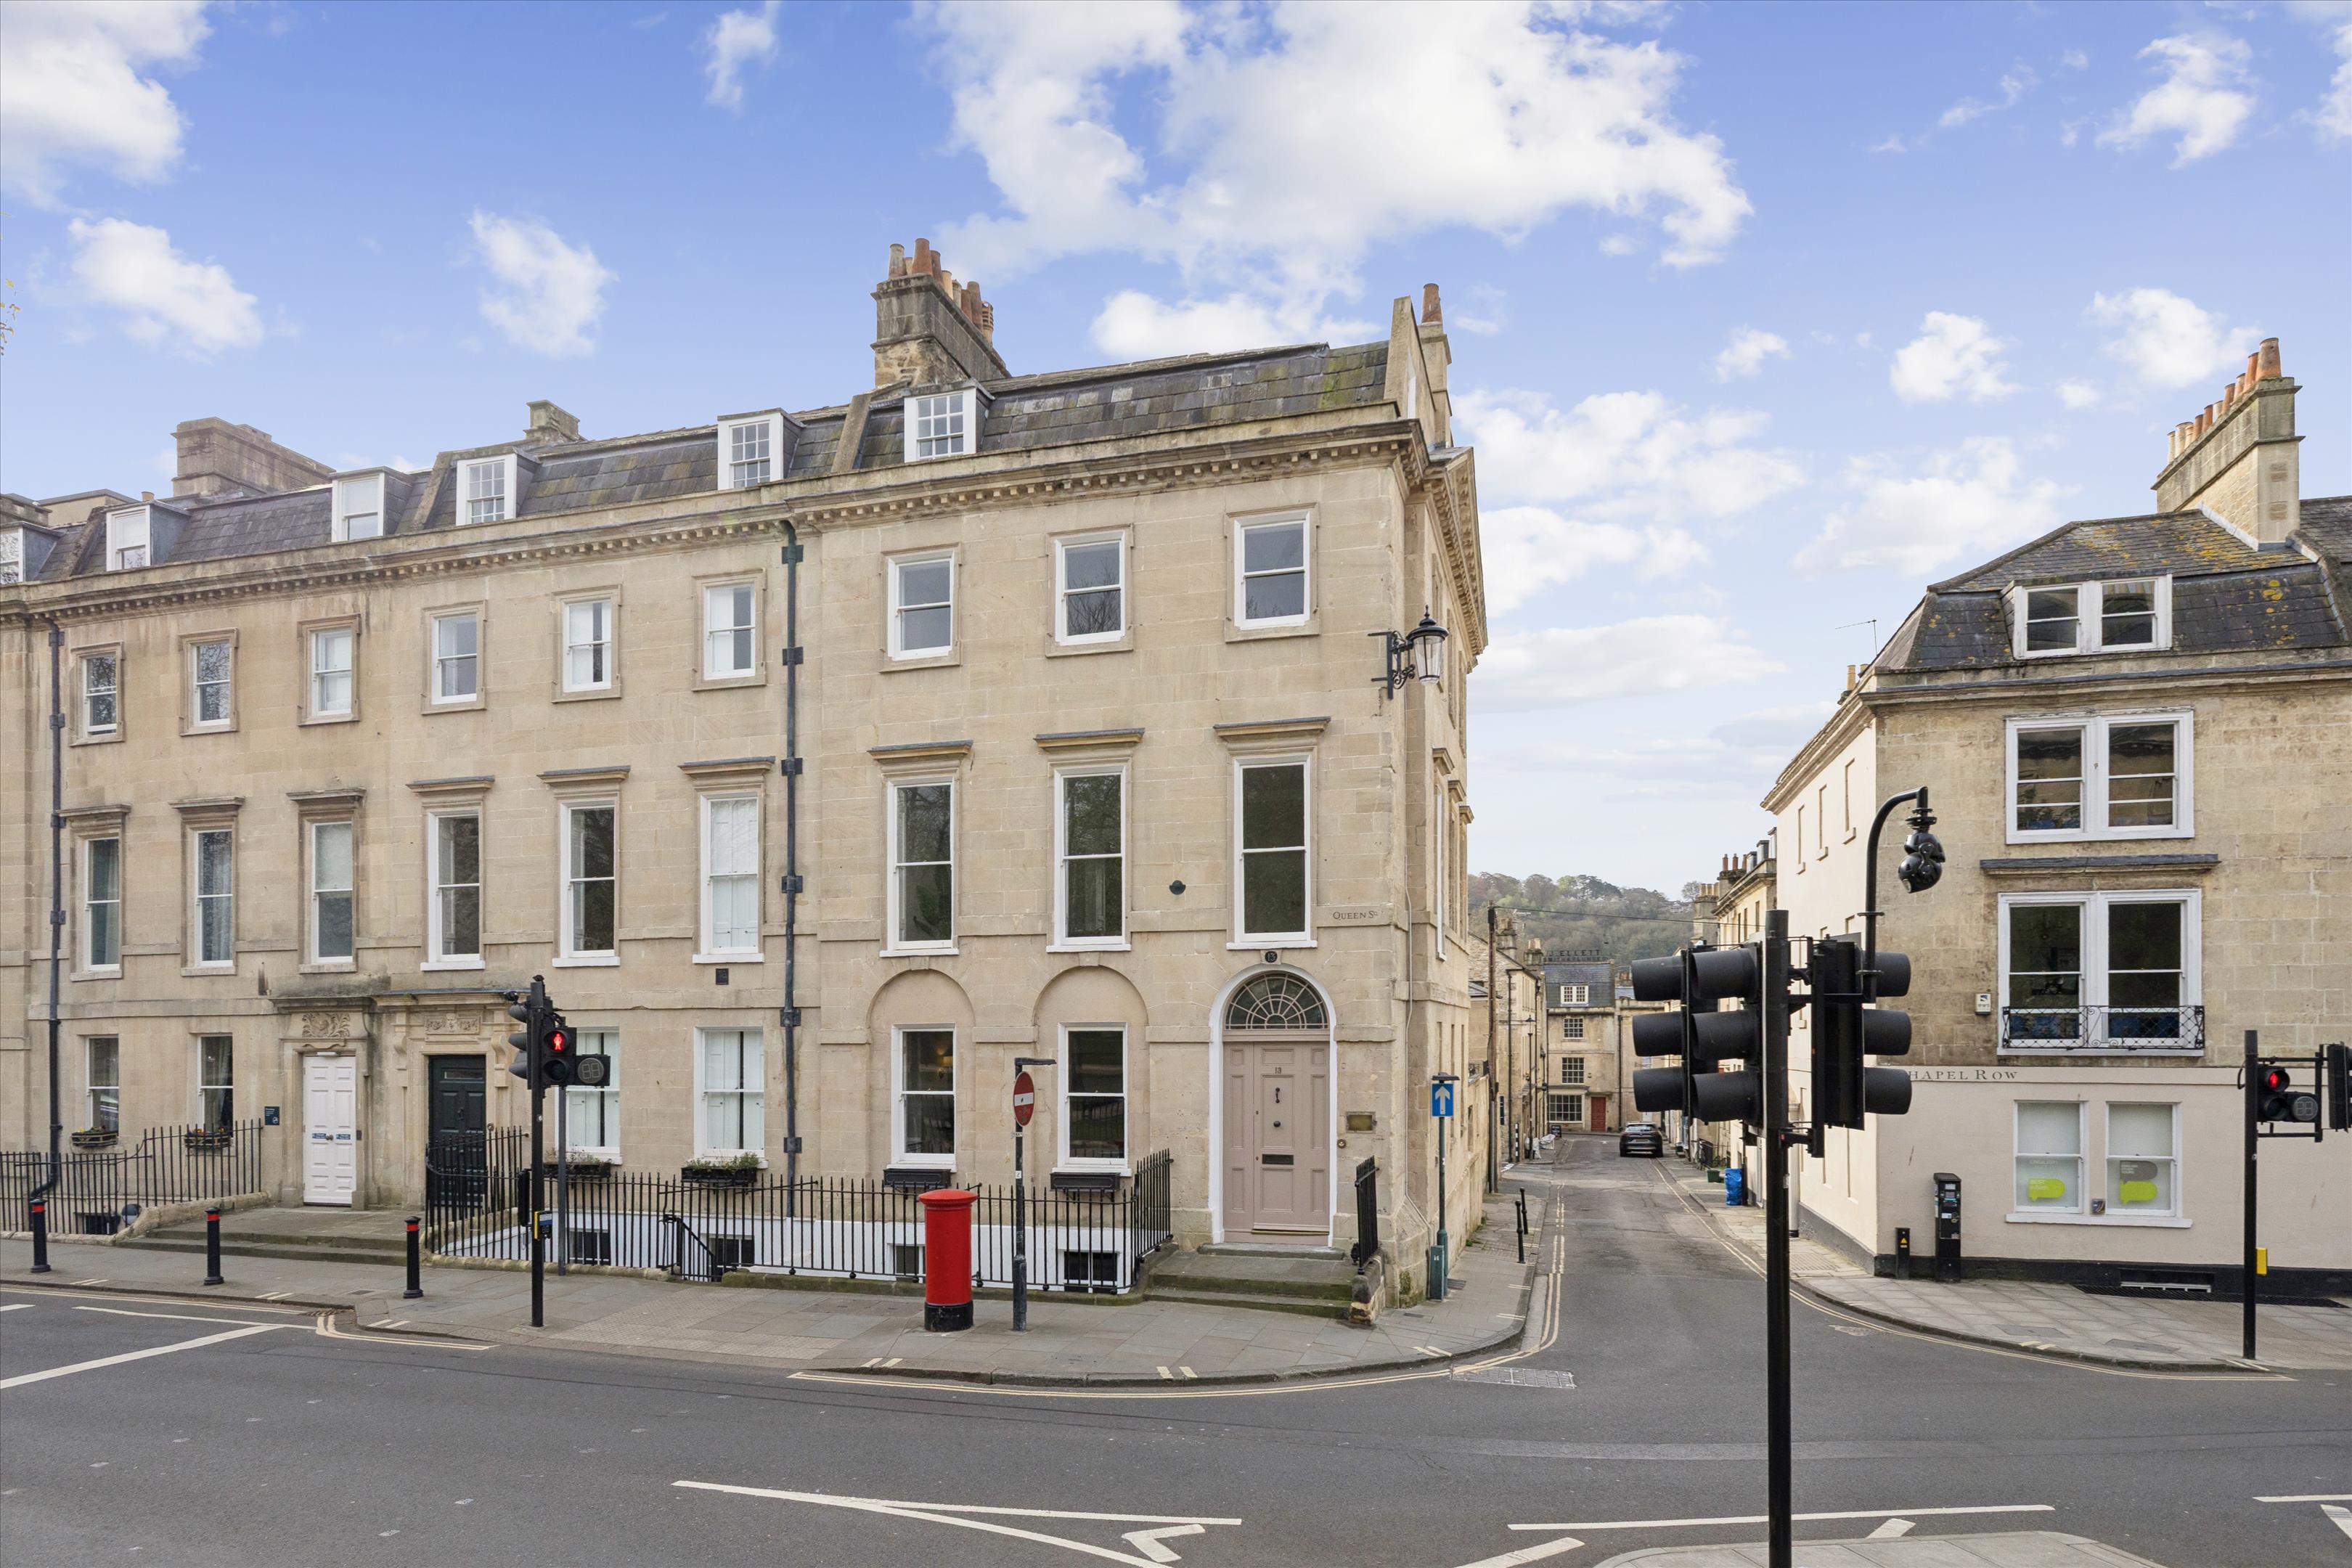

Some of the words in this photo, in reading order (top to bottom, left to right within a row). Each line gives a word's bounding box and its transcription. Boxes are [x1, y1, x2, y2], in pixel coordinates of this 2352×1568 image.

[1333, 911, 1366, 920] QUEEN
[1267, 952, 1276, 962] 13
[1908, 1071, 1968, 1080] HAPEL
[1975, 1069, 2017, 1080] ROW
